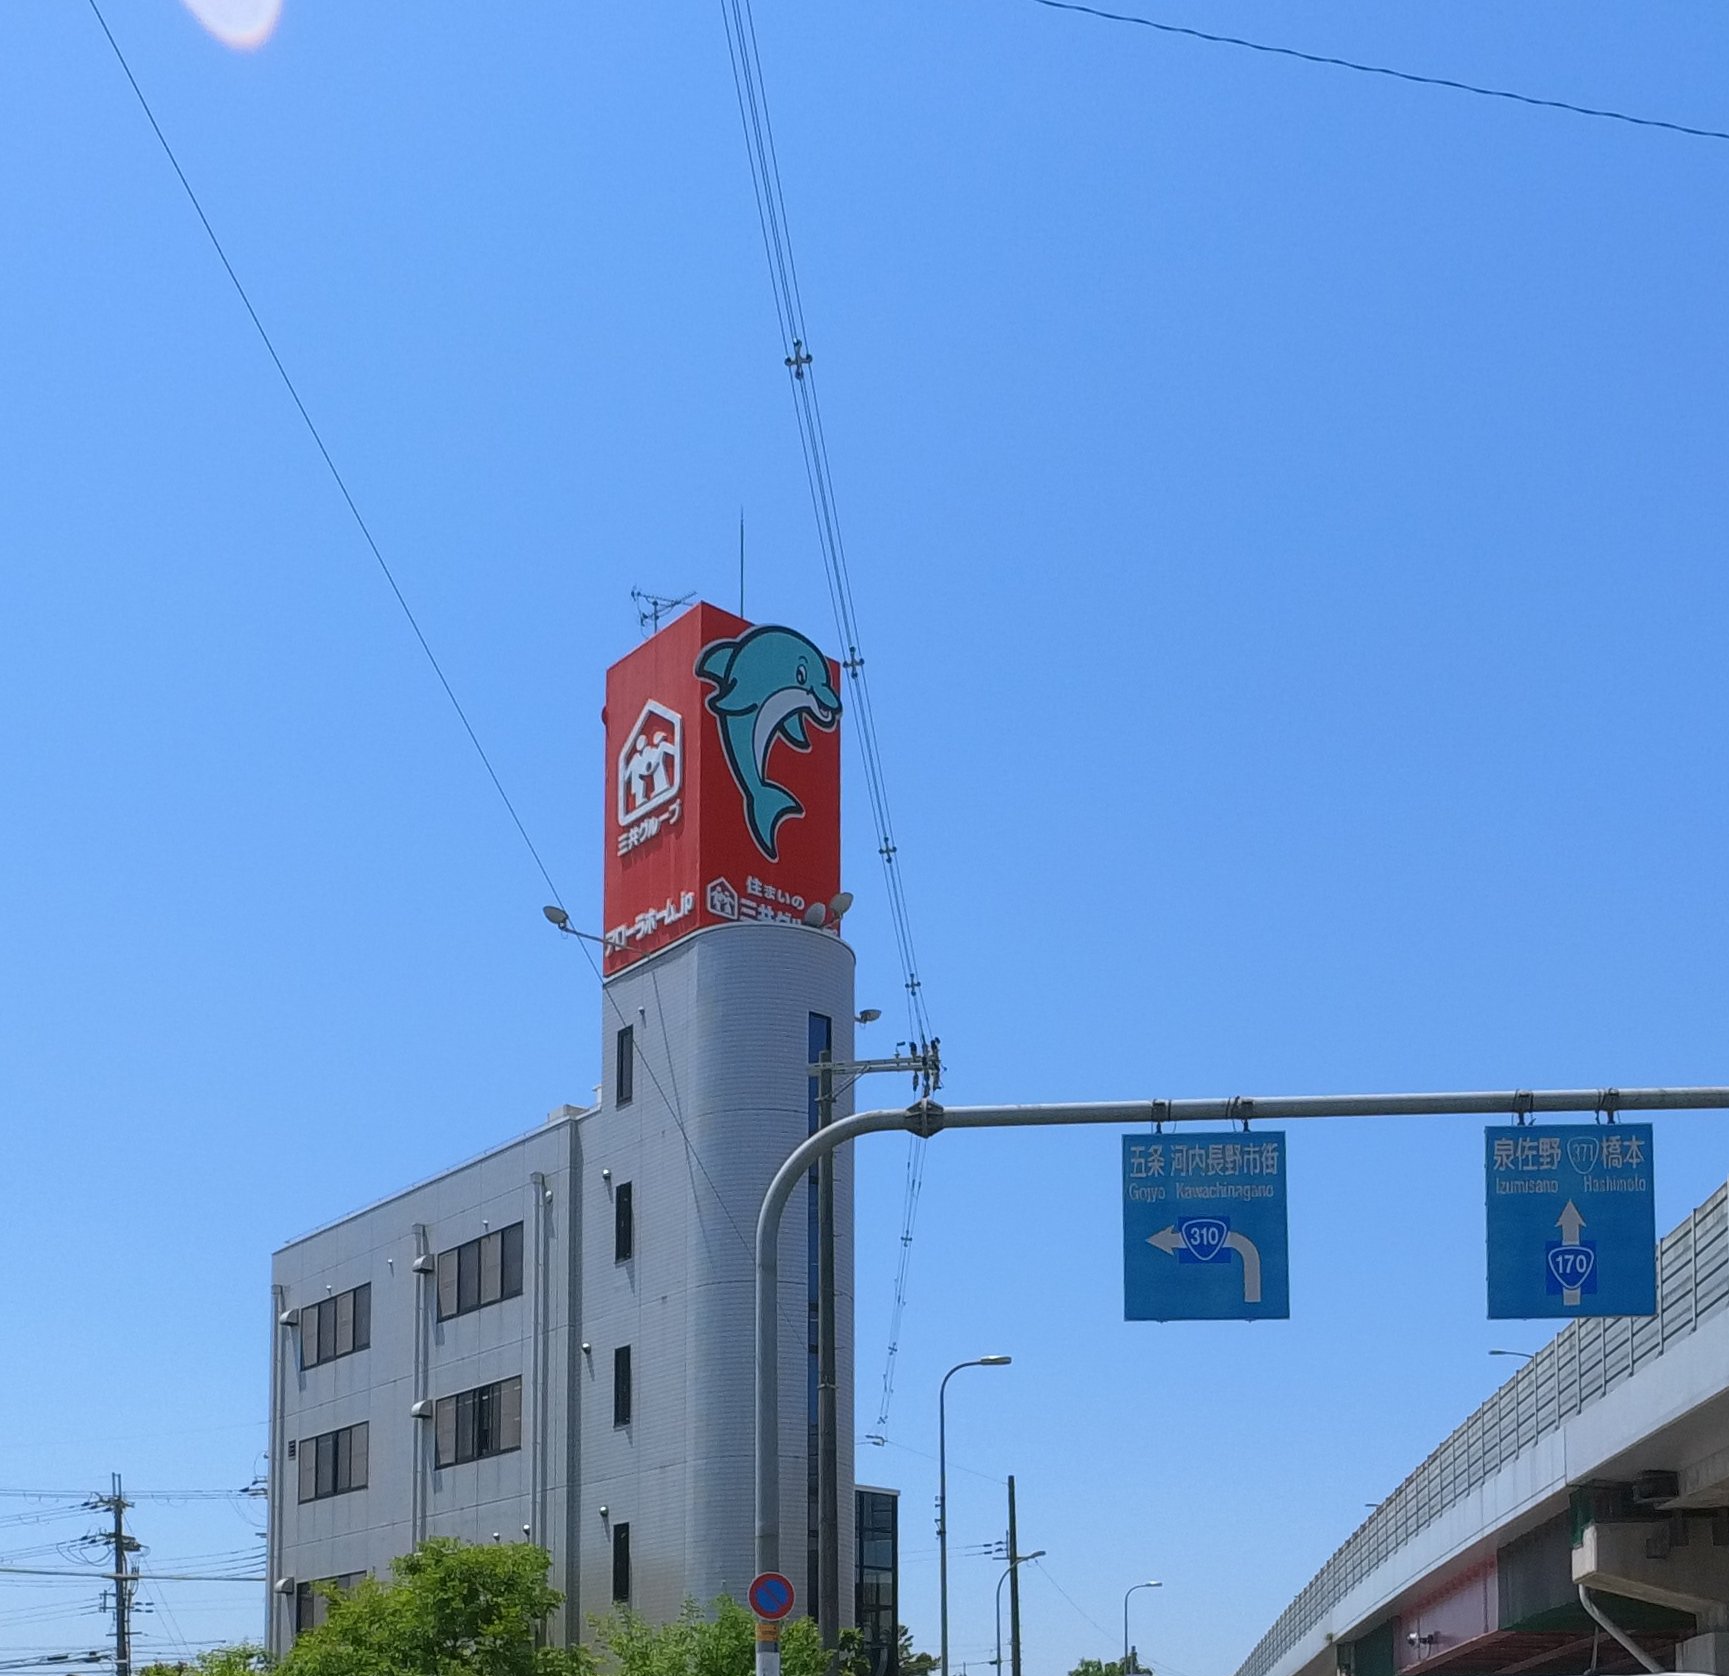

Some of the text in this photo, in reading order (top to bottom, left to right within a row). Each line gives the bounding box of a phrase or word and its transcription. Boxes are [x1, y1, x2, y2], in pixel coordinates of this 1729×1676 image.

[617, 799, 681, 857] 三共グループ
[746, 875, 805, 910] 住まいの
[1130, 1142, 1280, 1178] 五条 河内長野市街
[1493, 1135, 1645, 1171] 泉佐野 371 橋本
[1129, 1182, 1273, 1202] Gojyo Kawachinagano
[1496, 1175, 1646, 1194] Izumisano Hashimoto
[1190, 1227, 1218, 1246] 310
[1555, 1255, 1587, 1274] 170
